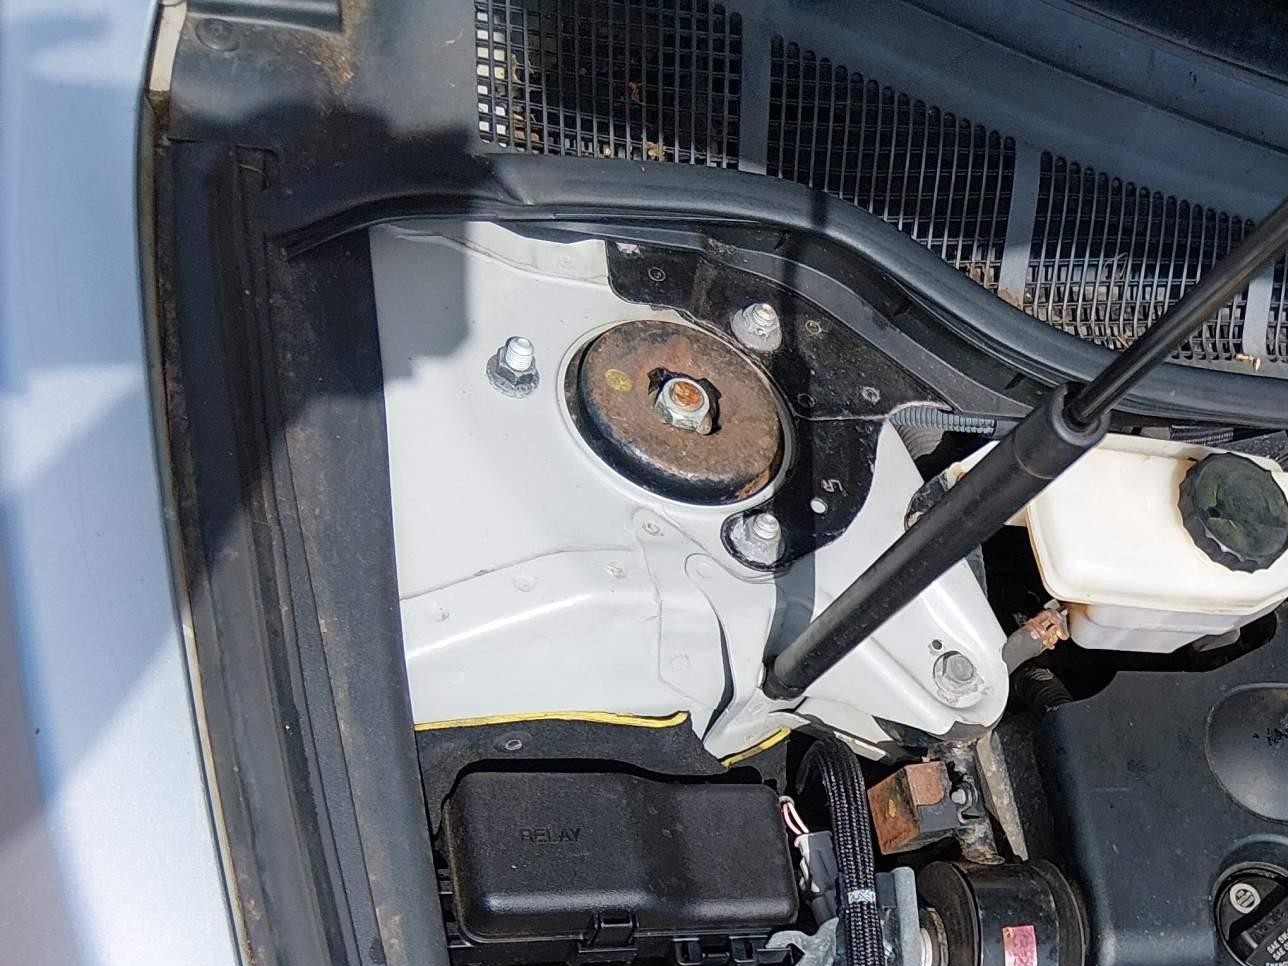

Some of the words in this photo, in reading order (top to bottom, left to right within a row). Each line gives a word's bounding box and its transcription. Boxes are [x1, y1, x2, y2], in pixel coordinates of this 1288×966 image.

[520, 827, 581, 843] RELAY
[1267, 940, 1280, 954] SAE
[1273, 947, 1286, 960] SAE
